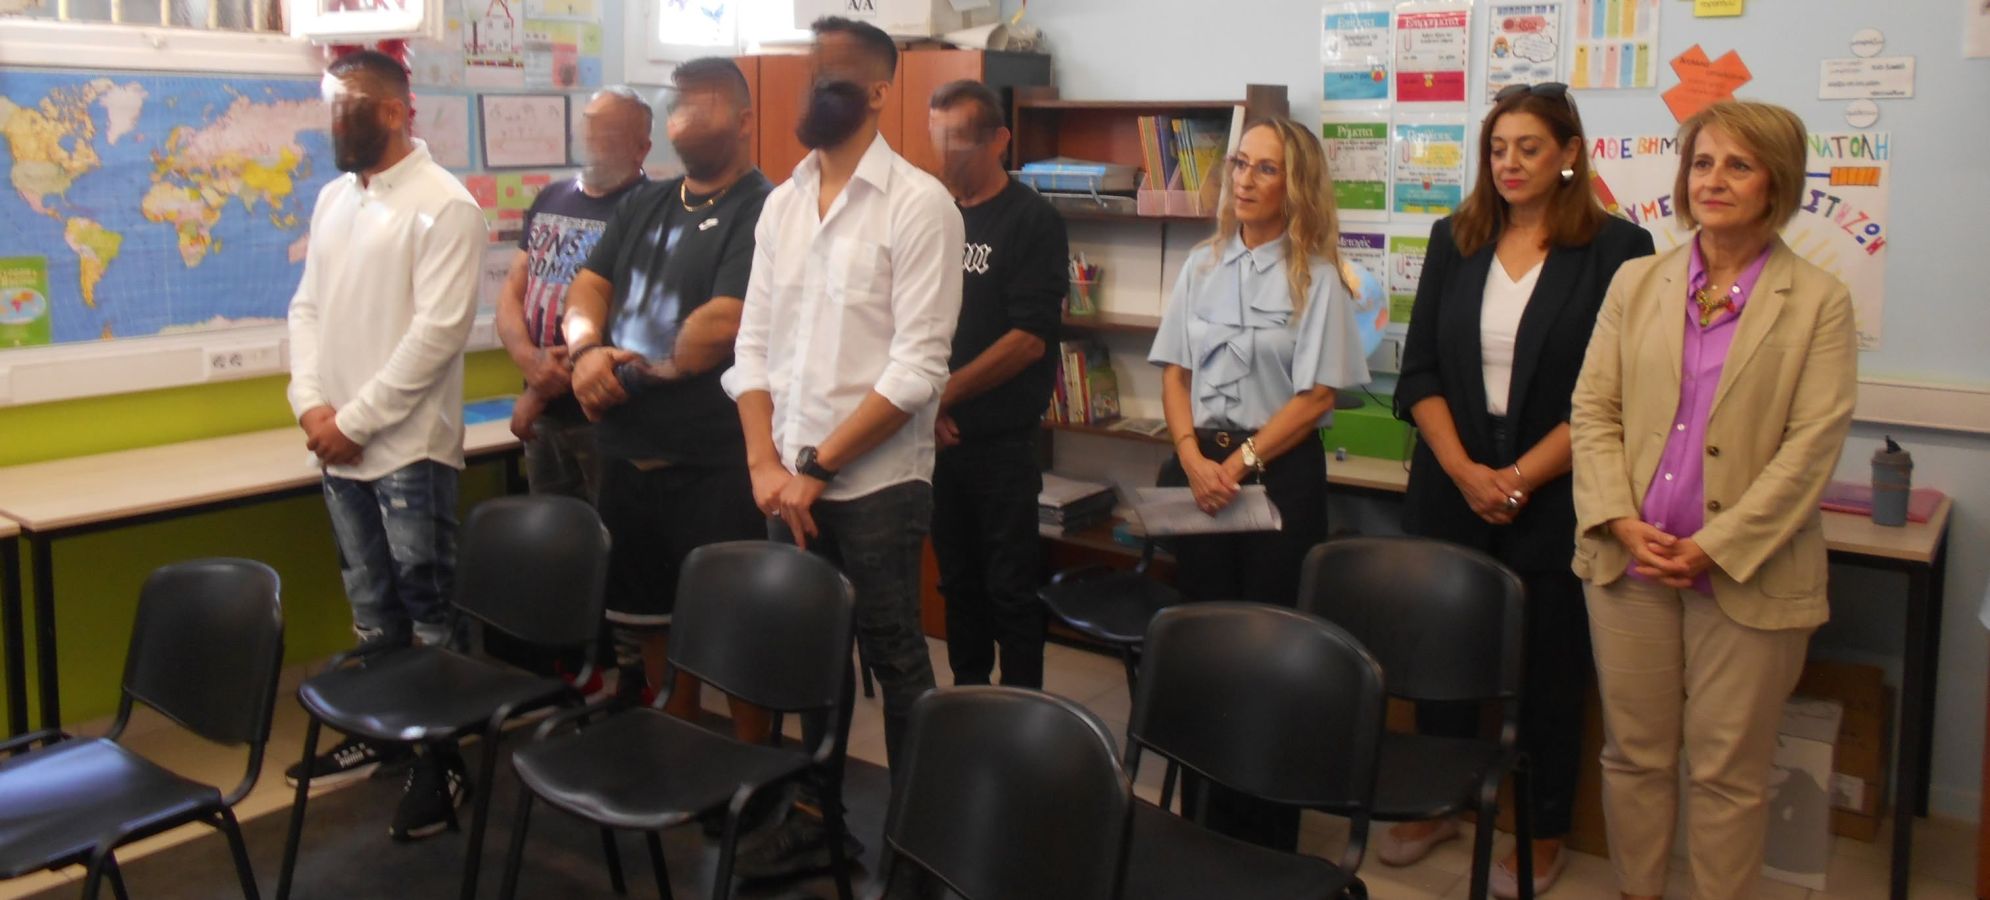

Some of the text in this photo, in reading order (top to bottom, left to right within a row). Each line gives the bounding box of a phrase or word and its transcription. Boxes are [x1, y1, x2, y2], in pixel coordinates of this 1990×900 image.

[1591, 133, 1888, 160] ΑΘΕ ΒΗΜ ΝΑΤΟΛΗ
